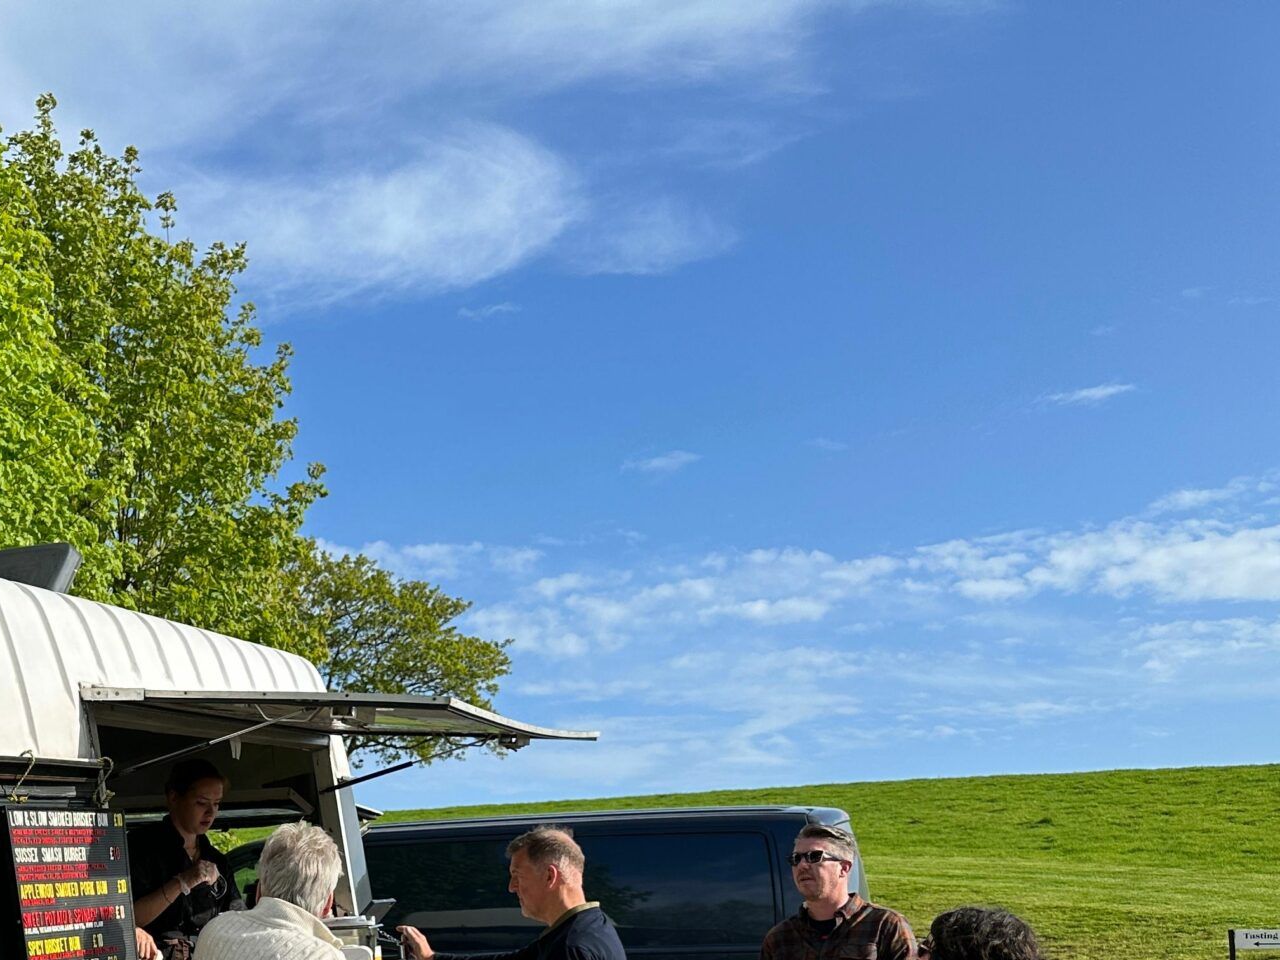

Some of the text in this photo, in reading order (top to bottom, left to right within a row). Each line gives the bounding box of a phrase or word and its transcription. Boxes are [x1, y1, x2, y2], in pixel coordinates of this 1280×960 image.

[9, 811, 24, 826] LOW
[30, 811, 47, 826] SLOW
[48, 811, 73, 826] SMOKED
[73, 812, 96, 826] BRISKET
[97, 812, 108, 827] BUN
[14, 847, 38, 862] SUSSEX
[42, 847, 62, 862] SMASH
[64, 846, 86, 861] BURGER
[20, 880, 127, 900] APPLEWOOD SMOKED PORK BUN £10
[23, 911, 42, 928] SWEET
[44, 910, 68, 926] POTATO
[74, 908, 98, 923] SPINACH
[28, 940, 44, 956] SPICY
[45, 938, 67, 954] BRISKET
[68, 936, 81, 951] BUN
[93, 934, 103, 948] £10
